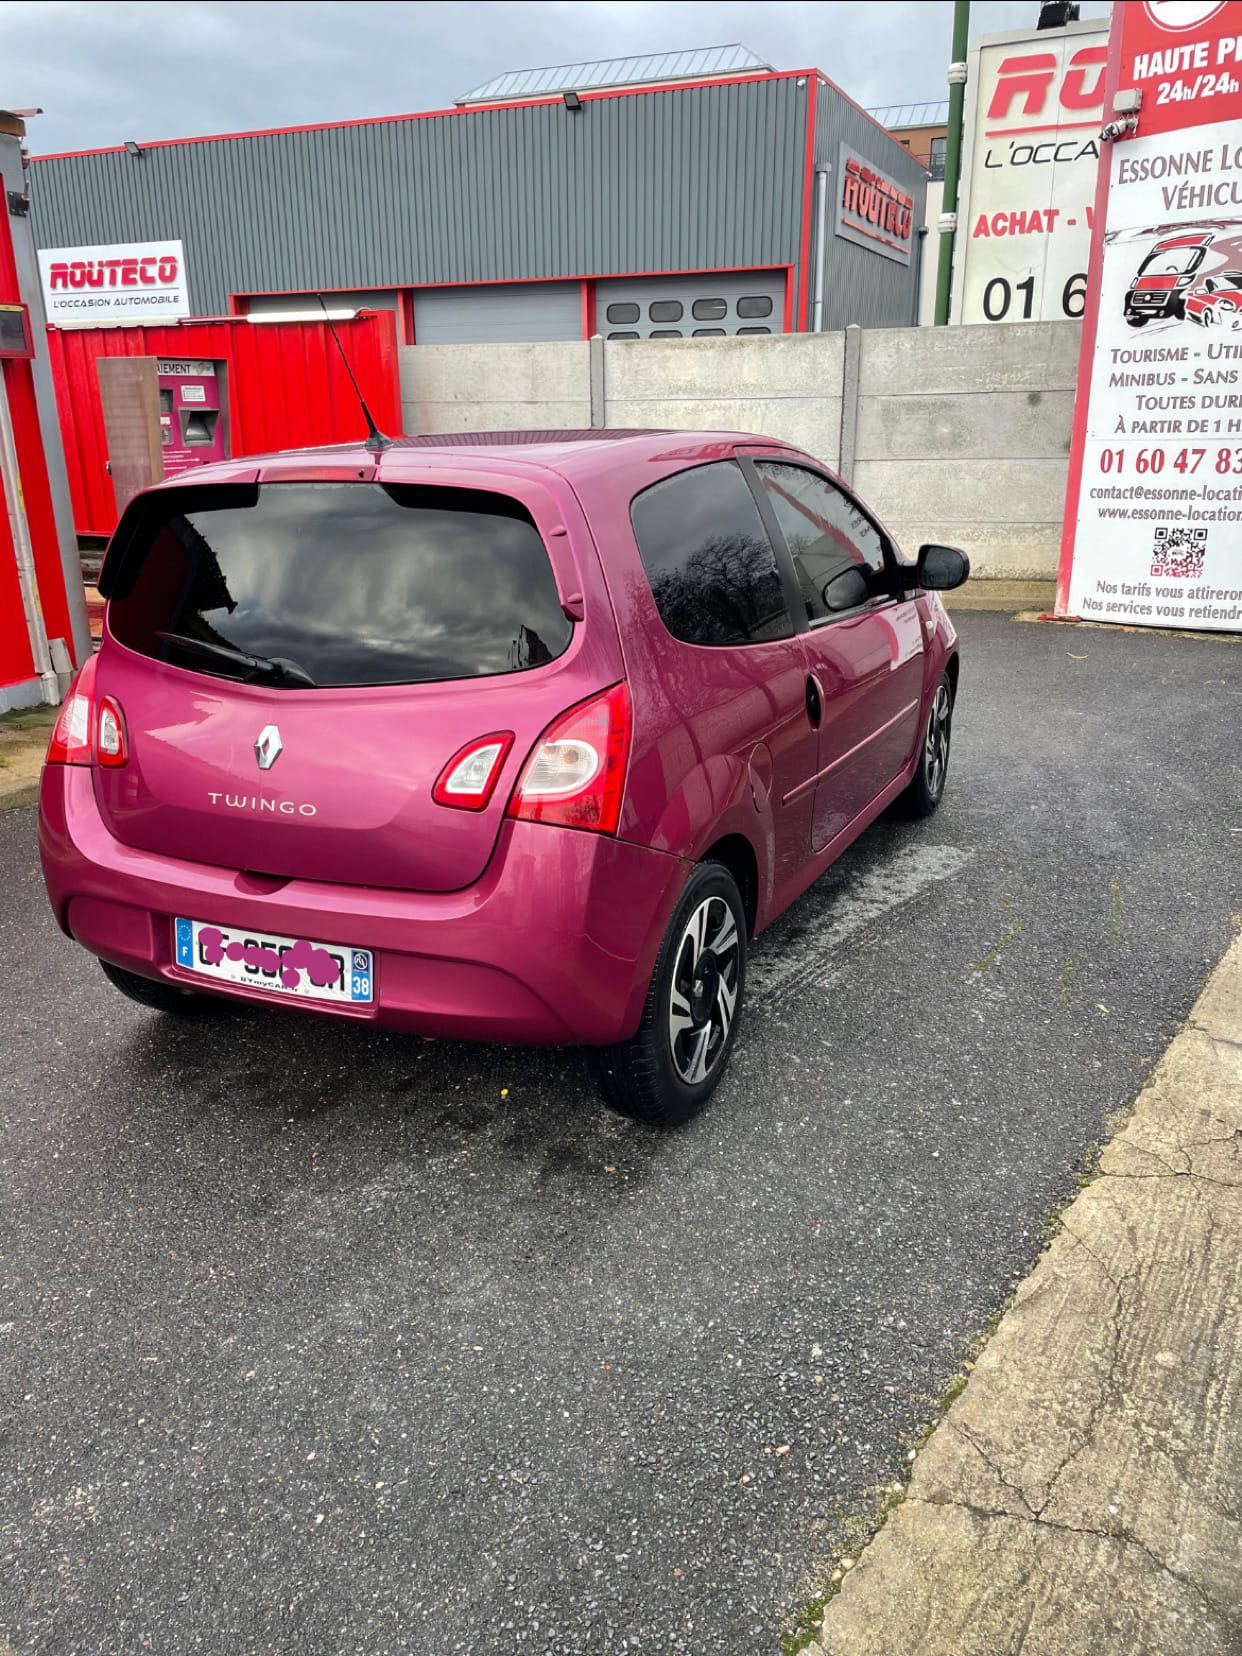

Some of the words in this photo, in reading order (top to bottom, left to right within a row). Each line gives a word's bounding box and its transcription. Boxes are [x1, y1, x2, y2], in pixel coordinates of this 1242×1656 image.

[1133, 41, 1210, 80] HAUTE
[1156, 72, 1240, 105] 24h/24h
[984, 140, 1099, 169] L'OCCA
[1119, 149, 1213, 185] ESSONNE
[973, 209, 1060, 238] ACHAT
[50, 256, 177, 289] ROUTECO
[53, 298, 111, 309] L'OCCASION
[113, 295, 180, 306] AUTOMOBILE
[983, 276, 1034, 321] 01
[1062, 273, 1088, 318] 6
[1111, 347, 1189, 364] TOURISME
[1207, 343, 1242, 360] UTI
[1109, 372, 1176, 388] MINIBUS
[1193, 368, 1239, 385] SANS
[1136, 395, 1196, 410] TOUTES
[1201, 395, 1242, 409] DUR
[1114, 414, 1126, 434] À
[1131, 420, 1182, 433] PARTIR
[1187, 419, 1209, 433] DE
[1213, 419, 1222, 433] 1
[1100, 448, 1125, 474] 01
[1135, 448, 1165, 474] 60
[1173, 448, 1207, 474] 47
[1215, 447, 1242, 475] 83
[1096, 580, 1118, 594] Nos
[1121, 582, 1151, 597] tarifs
[1155, 587, 1184, 599] vous
[1082, 597, 1103, 611] Nos
[1106, 600, 1152, 615] services
[1156, 604, 1185, 617] vous
[207, 792, 317, 816] TWINGO
[353, 976, 369, 995] 38
